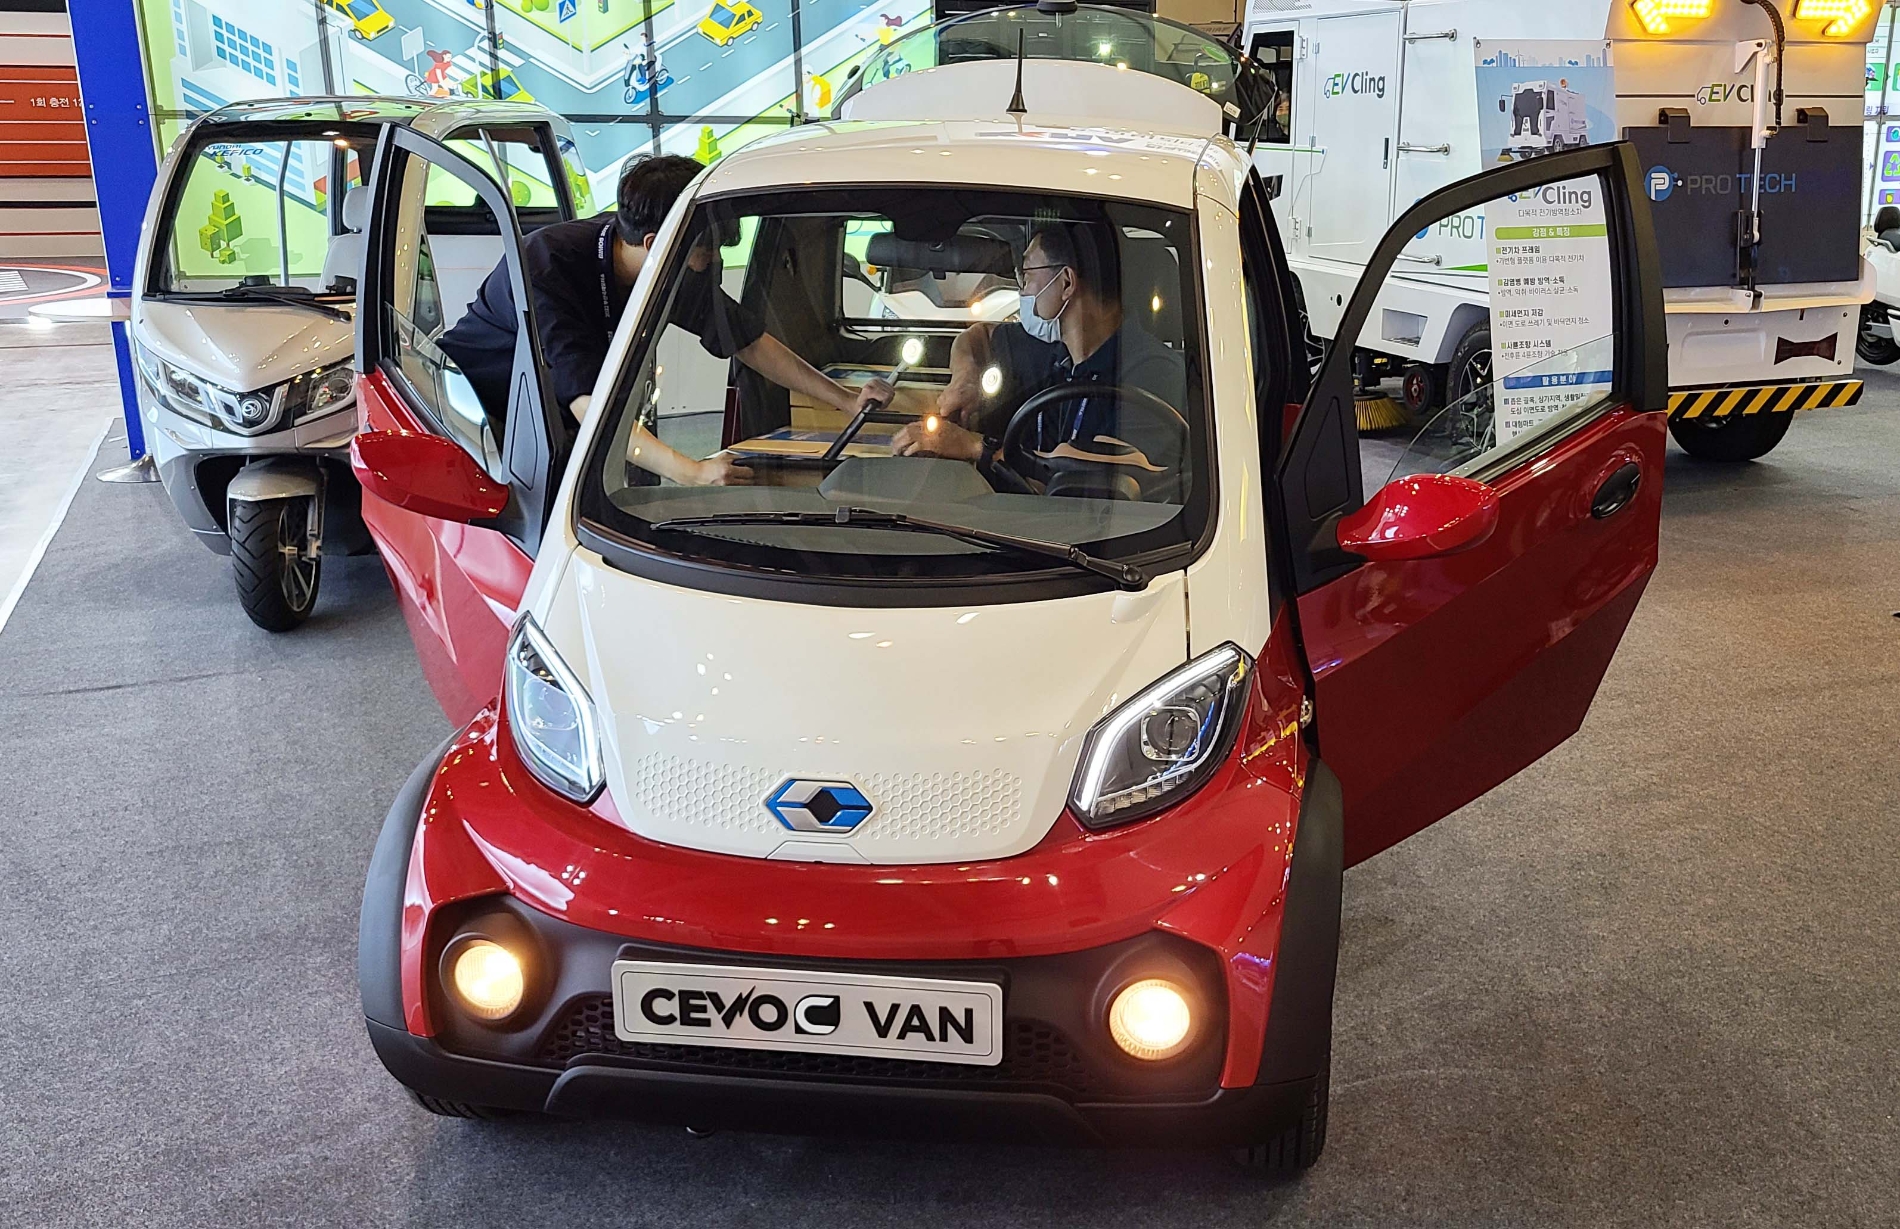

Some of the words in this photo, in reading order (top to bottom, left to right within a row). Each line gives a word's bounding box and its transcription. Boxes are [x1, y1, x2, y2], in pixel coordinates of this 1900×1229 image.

[1351, 71, 1386, 98] Cling
[30, 97, 47, 108] 1회
[49, 97, 70, 108] 충전
[210, 148, 264, 157] KEFICO
[1687, 175, 1732, 195] PRO
[1736, 173, 1796, 193] TECH
[1542, 186, 1592, 208] Cling
[1438, 215, 1475, 240] PRO
[1549, 228, 1554, 236] &
[1501, 246, 1520, 254] 전기차
[1521, 245, 1540, 254] 프레임
[1505, 309, 1529, 318] 미세먼지
[1533, 339, 1552, 348] 시스템
[863, 1001, 974, 1044] VAN
